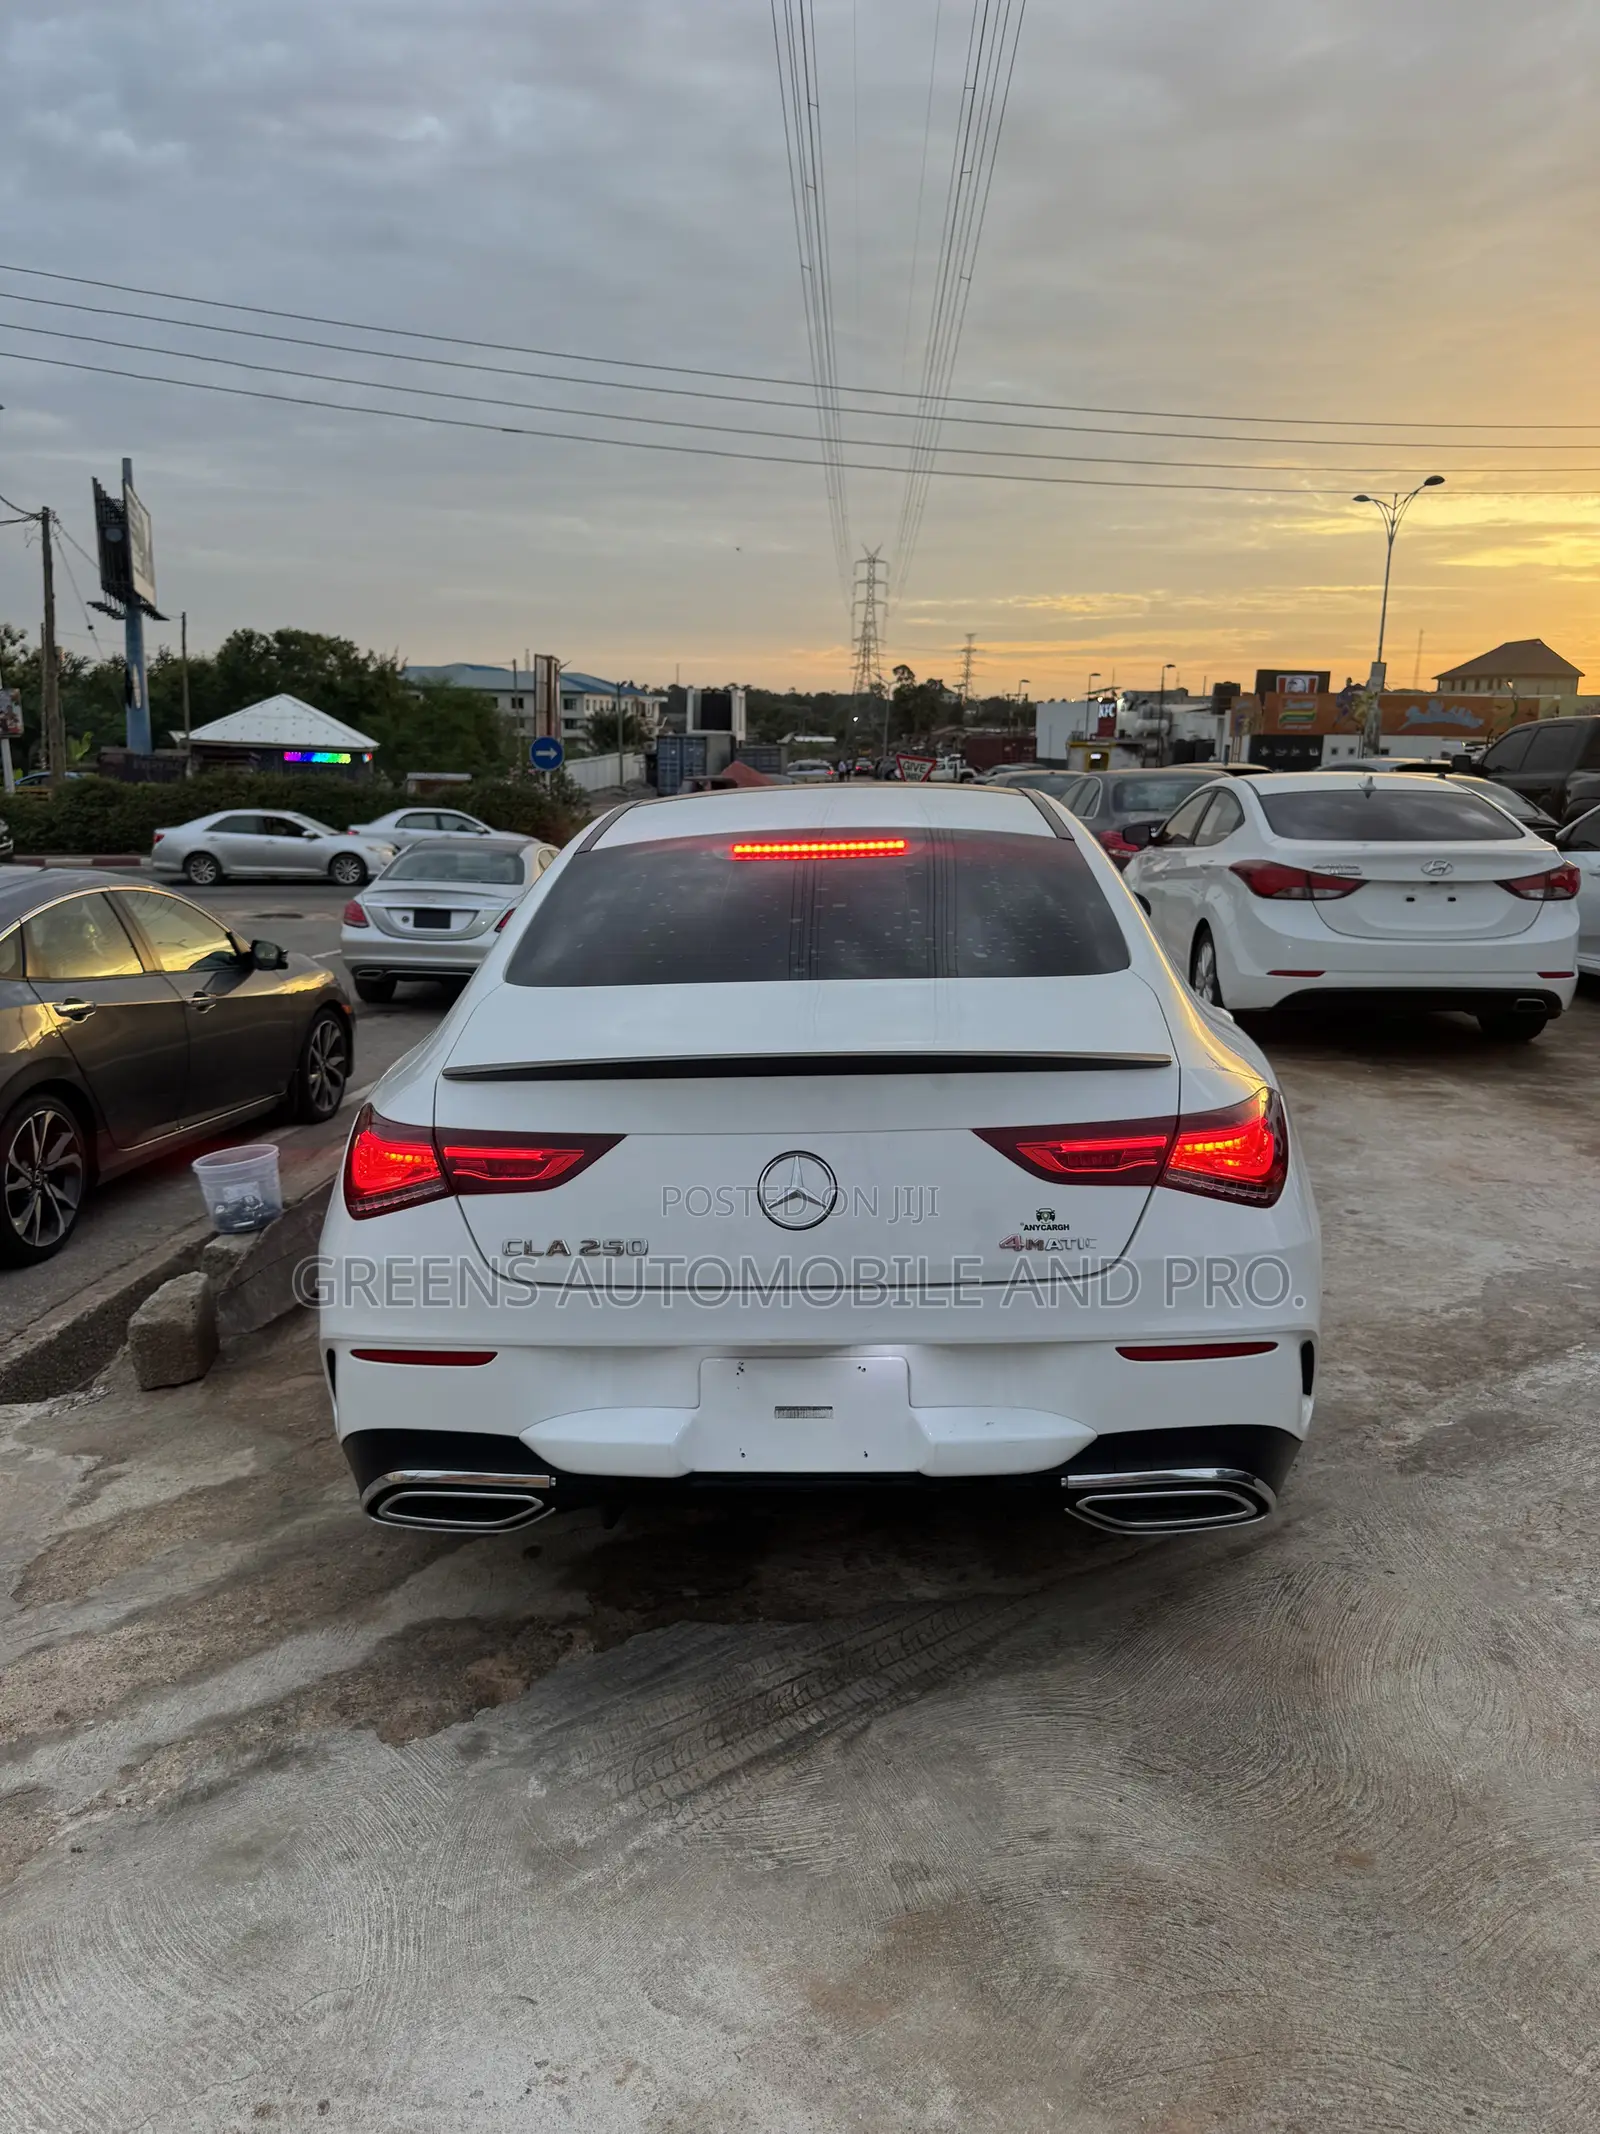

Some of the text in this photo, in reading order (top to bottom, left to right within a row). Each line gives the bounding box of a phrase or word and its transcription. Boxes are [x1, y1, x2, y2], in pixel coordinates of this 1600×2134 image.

[1098, 703, 1116, 718] KFC
[902, 760, 927, 773] GIVE
[502, 1238, 649, 1257] CLA 250
[999, 1233, 1098, 1252] 4MATIC
